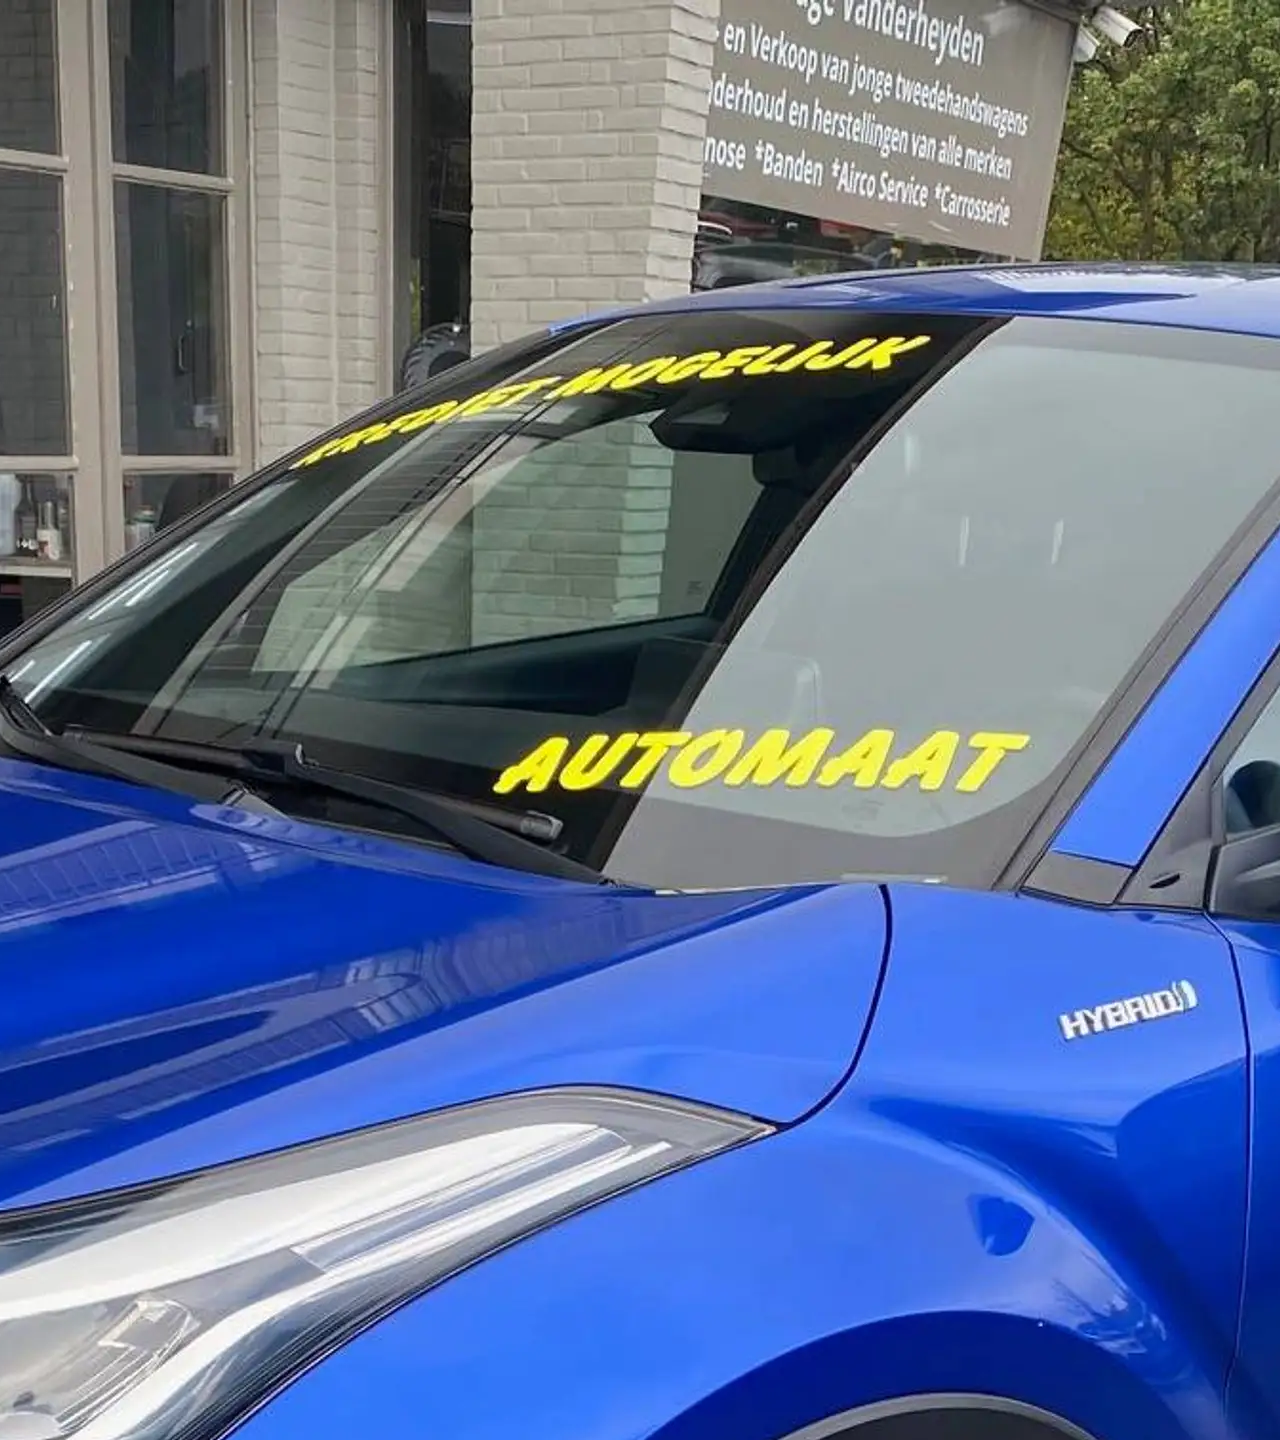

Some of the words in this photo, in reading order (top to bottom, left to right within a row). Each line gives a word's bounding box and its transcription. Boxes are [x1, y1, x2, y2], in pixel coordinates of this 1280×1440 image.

[843, 0, 984, 66] Vanderheyden
[723, 23, 746, 54] en
[751, 23, 818, 84] Verkoop
[821, 53, 849, 84] van
[848, 54, 893, 103] jonge
[895, 72, 1029, 138] tweedehandswagens
[709, 72, 787, 123] derhoud
[788, 99, 809, 130] en
[812, 97, 908, 158] herstellingen
[911, 132, 937, 161] van
[937, 134, 963, 167] alle
[963, 145, 1013, 180] merken
[702, 136, 746, 173] nose
[877, 170, 929, 208] Service
[542, 334, 932, 402] MOGELIJK
[492, 727, 1032, 795] AUTOMAAT
[1058, 986, 1182, 1041] HYBRID
